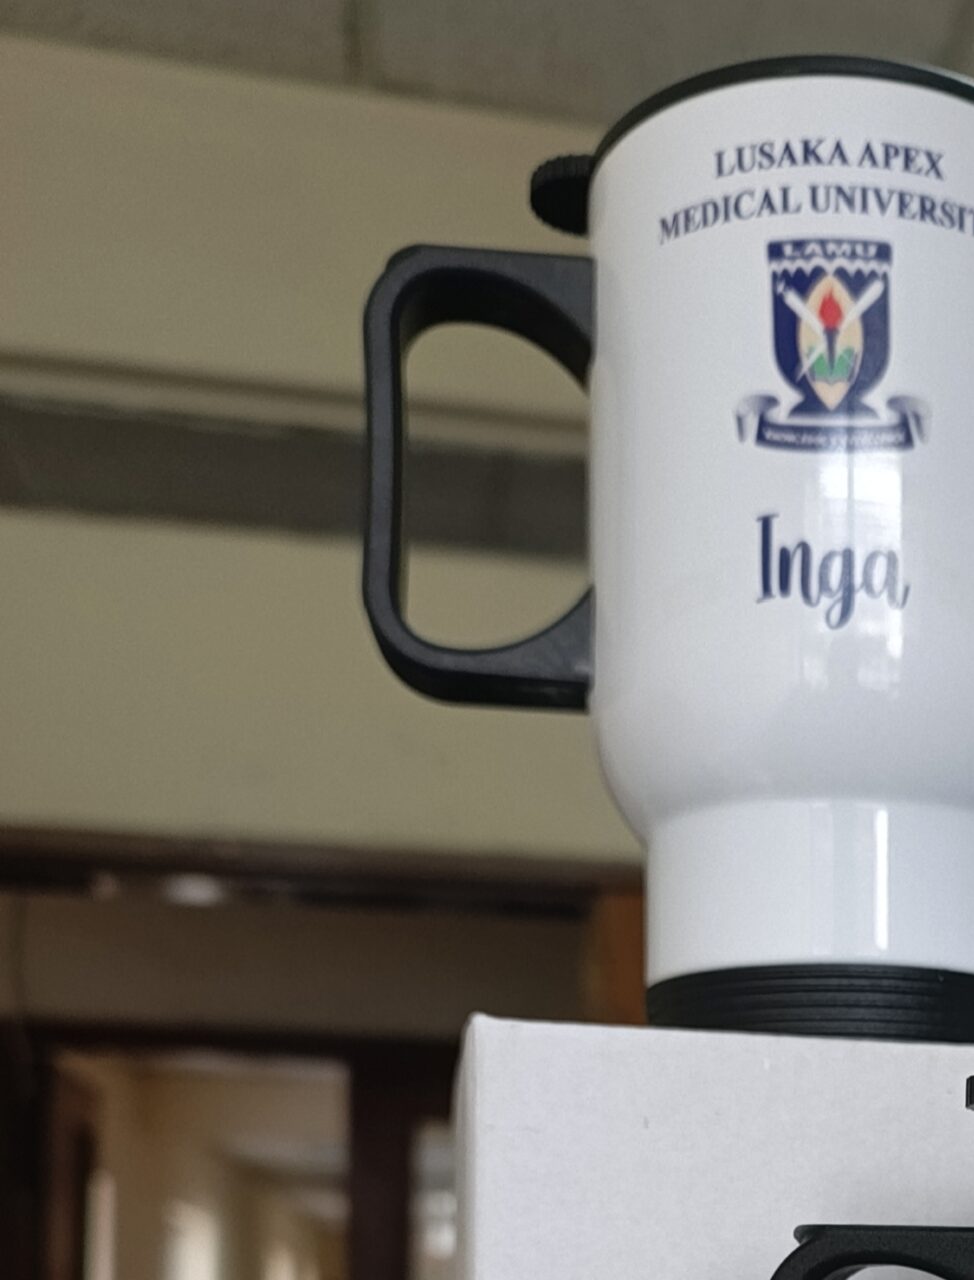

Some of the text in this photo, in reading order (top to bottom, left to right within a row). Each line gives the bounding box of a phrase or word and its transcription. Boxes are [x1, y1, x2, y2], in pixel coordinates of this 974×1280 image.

[714, 138, 945, 181] LUSAKA APEX
[658, 185, 801, 245] MEDICAL
[781, 242, 878, 259] LAMU
[755, 513, 911, 631] Inga
